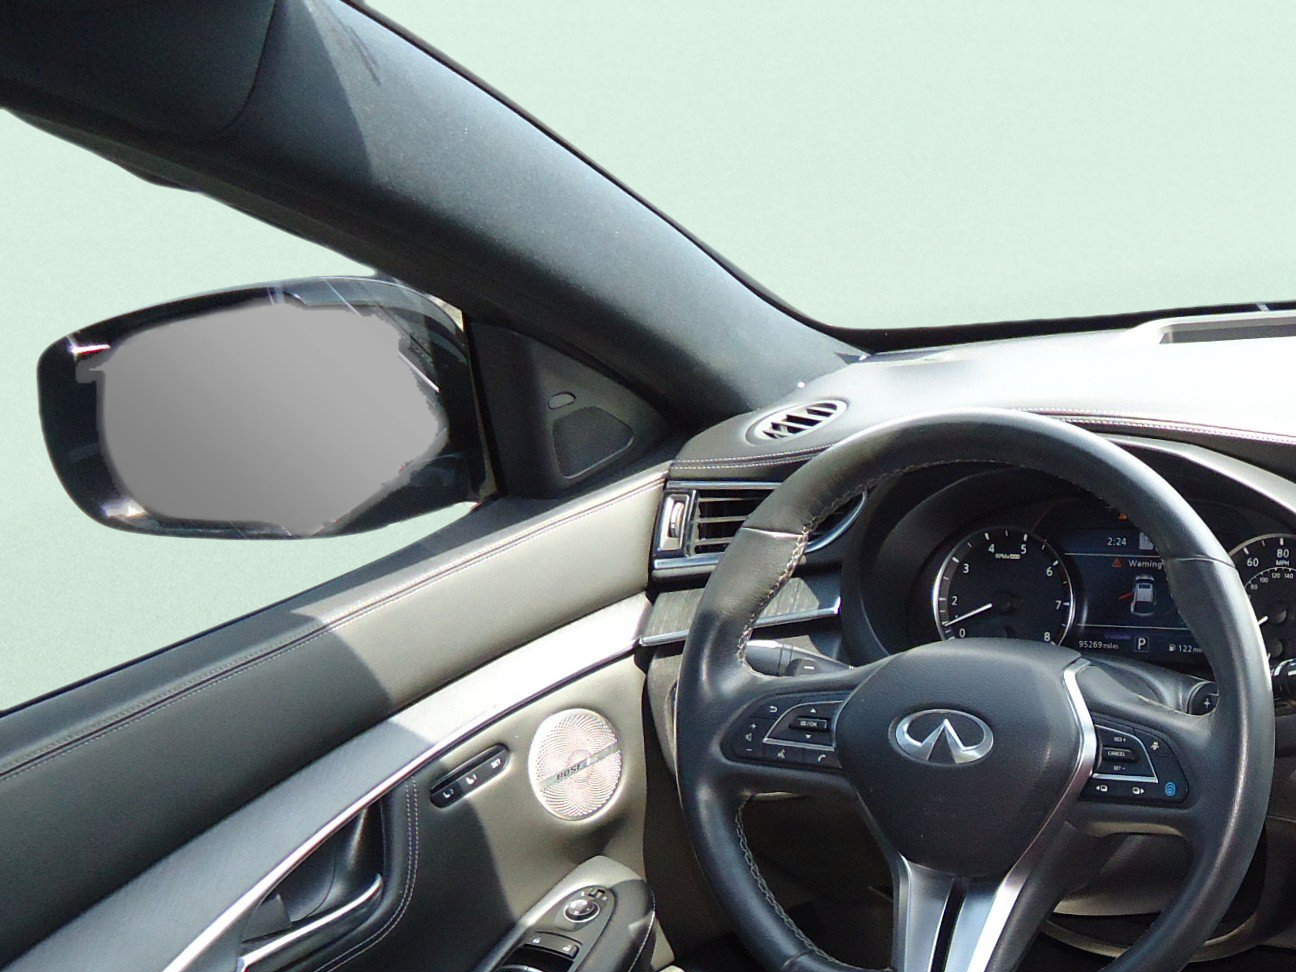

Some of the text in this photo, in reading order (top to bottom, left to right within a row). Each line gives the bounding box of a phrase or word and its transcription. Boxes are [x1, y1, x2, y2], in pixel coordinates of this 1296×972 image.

[1107, 537, 1127, 546] 2:24
[988, 543, 995, 553] 4
[1020, 544, 1027, 554] 5
[1276, 548, 1290, 558] 80
[1128, 559, 1164, 570] Warning
[1246, 557, 1260, 567] 60
[962, 563, 970, 574] 3
[1046, 567, 1053, 577] 6
[951, 595, 958, 606] 2
[1055, 600, 1062, 610] 7
[959, 628, 966, 638] 0
[1044, 632, 1051, 642] 8
[1137, 638, 1147, 650] P
[1178, 645, 1193, 653] 122
[556, 763, 582, 781] BOSE
